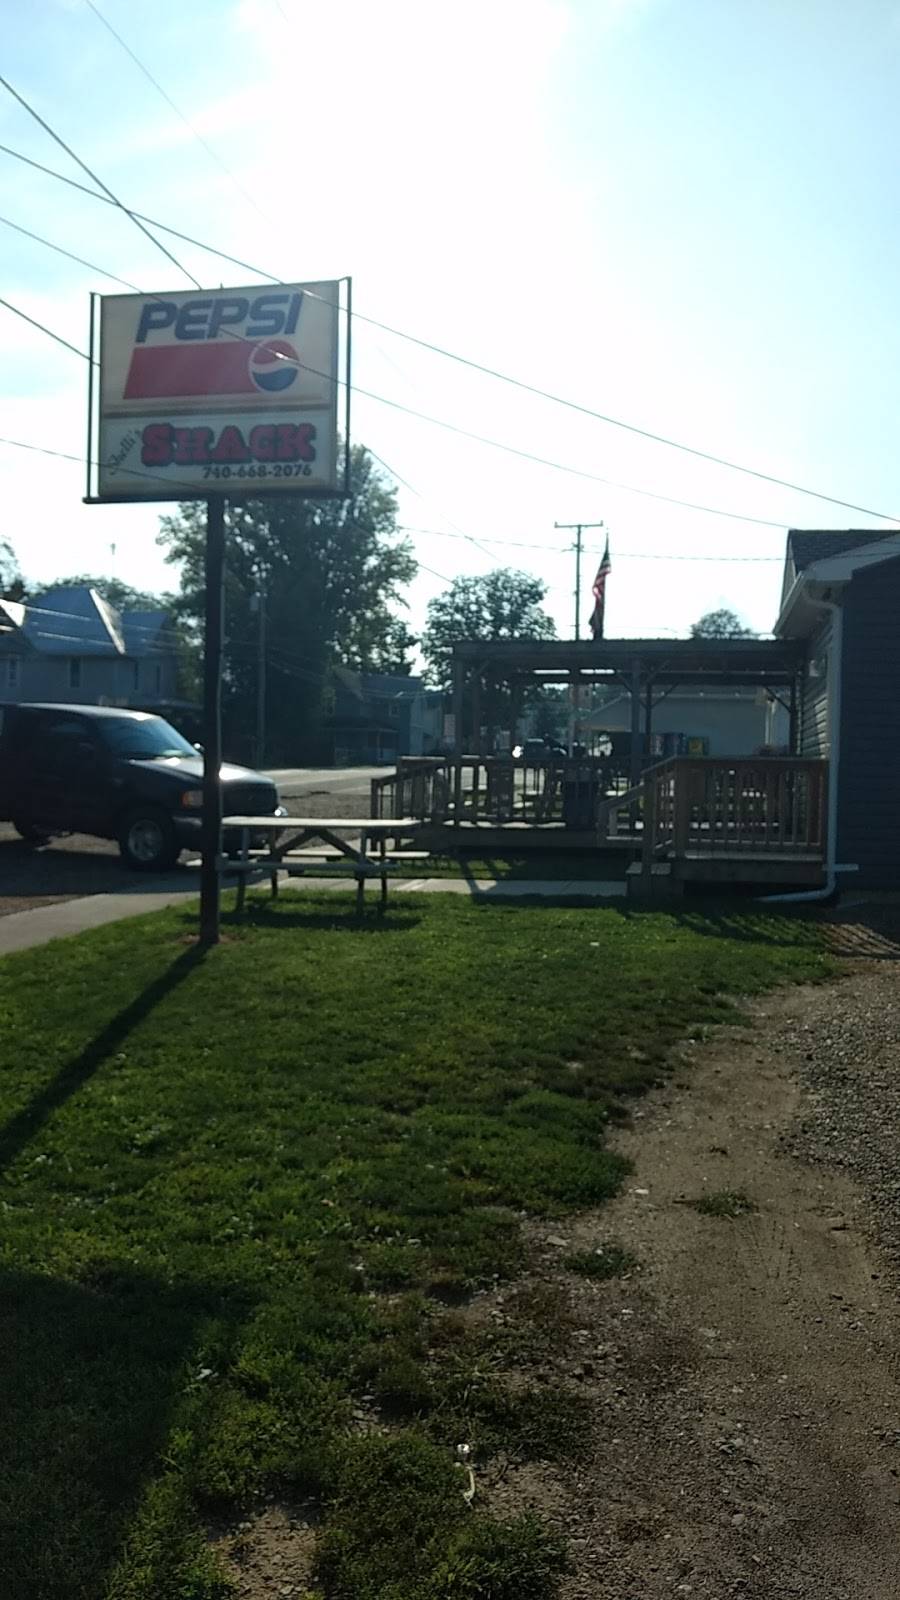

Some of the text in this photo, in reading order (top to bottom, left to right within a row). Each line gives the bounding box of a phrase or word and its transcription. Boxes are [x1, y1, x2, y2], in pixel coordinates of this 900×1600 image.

[136, 293, 303, 343] PEPSI
[141, 423, 317, 467] SHACK
[203, 464, 312, 479] 740-668-2076
